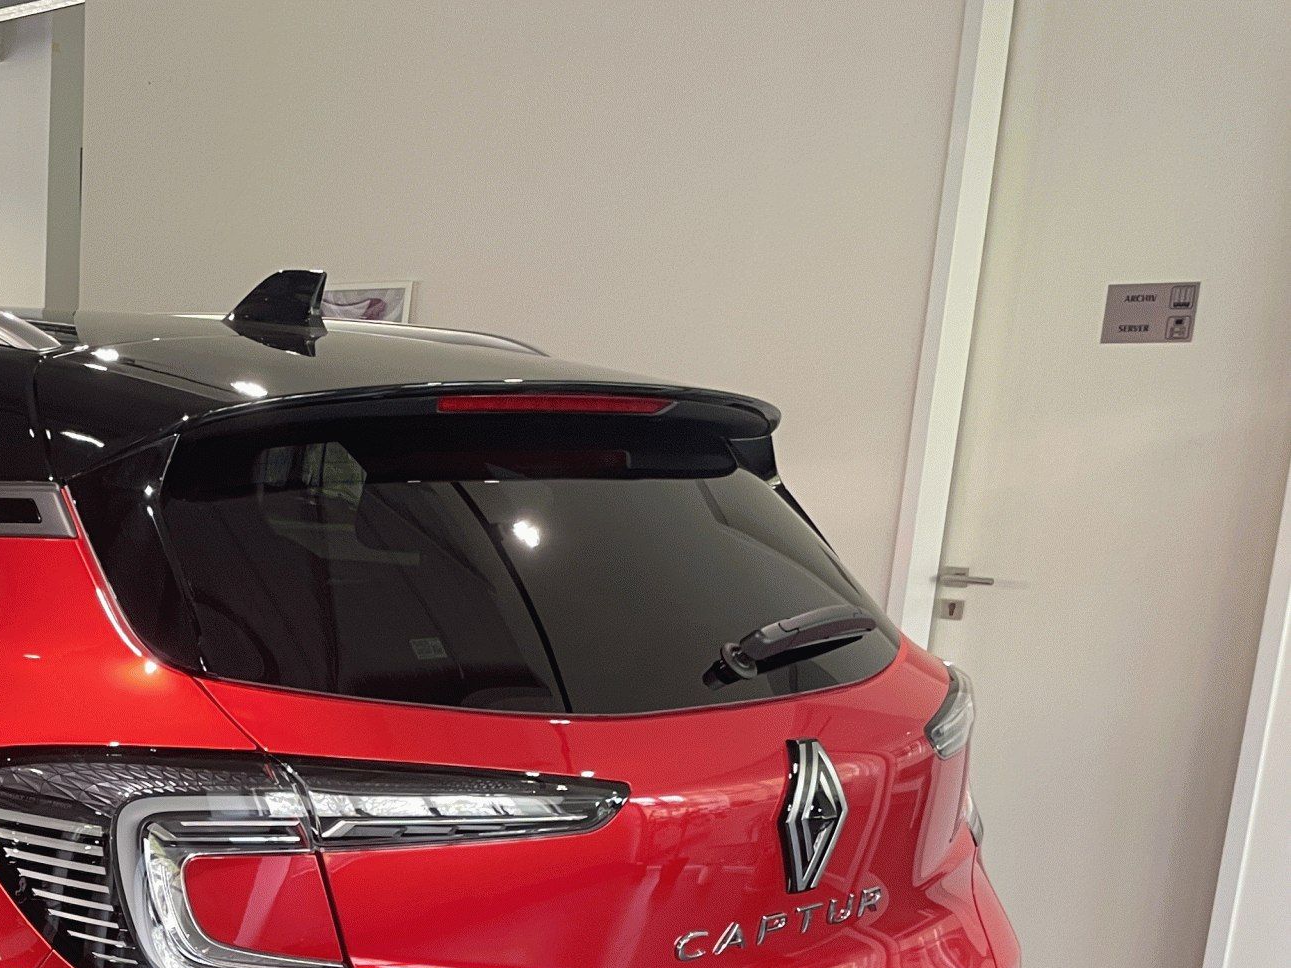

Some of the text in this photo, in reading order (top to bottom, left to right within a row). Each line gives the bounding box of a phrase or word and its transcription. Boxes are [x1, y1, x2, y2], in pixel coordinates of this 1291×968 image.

[1123, 294, 1157, 303] ARCHIV
[1118, 324, 1149, 333] SERVER
[674, 886, 882, 962] CAPTUR
